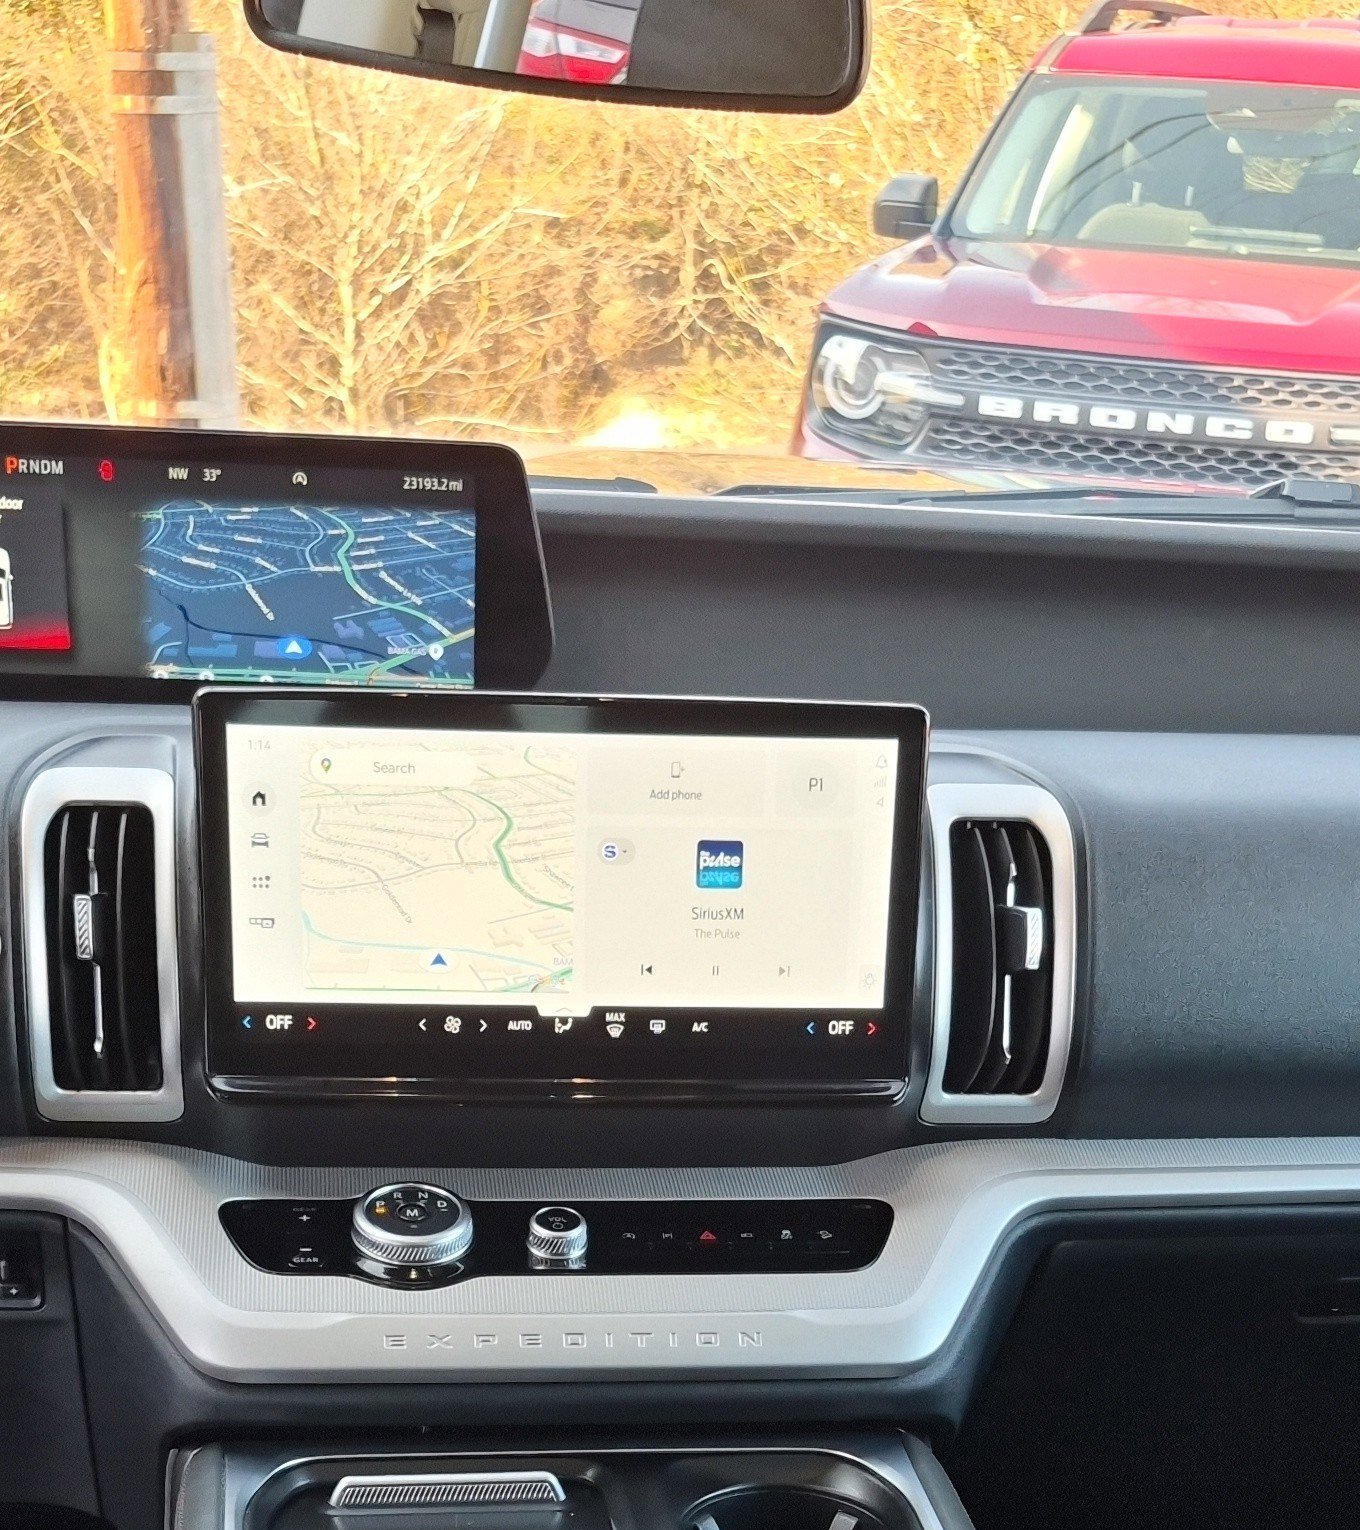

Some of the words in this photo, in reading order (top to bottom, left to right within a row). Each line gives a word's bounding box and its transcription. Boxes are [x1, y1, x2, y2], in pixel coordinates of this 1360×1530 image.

[977, 395, 1316, 443] BRONCO
[168, 467, 189, 481] NW
[373, 761, 416, 775] Search
[808, 777, 824, 792] P1
[649, 788, 669, 800] Add
[671, 789, 702, 802] phone
[699, 852, 741, 870] pulse
[691, 906, 745, 920] SiriusXM
[694, 928, 712, 939] The
[714, 928, 741, 939] Pulse
[265, 1014, 293, 1030] OFF
[605, 1012, 626, 1023] MAX
[507, 1020, 533, 1031] AUTO
[691, 1022, 709, 1033] A/C
[828, 1020, 854, 1035] OFF
[405, 1208, 419, 1218] M
[383, 1330, 763, 1350] EXPEDITION
